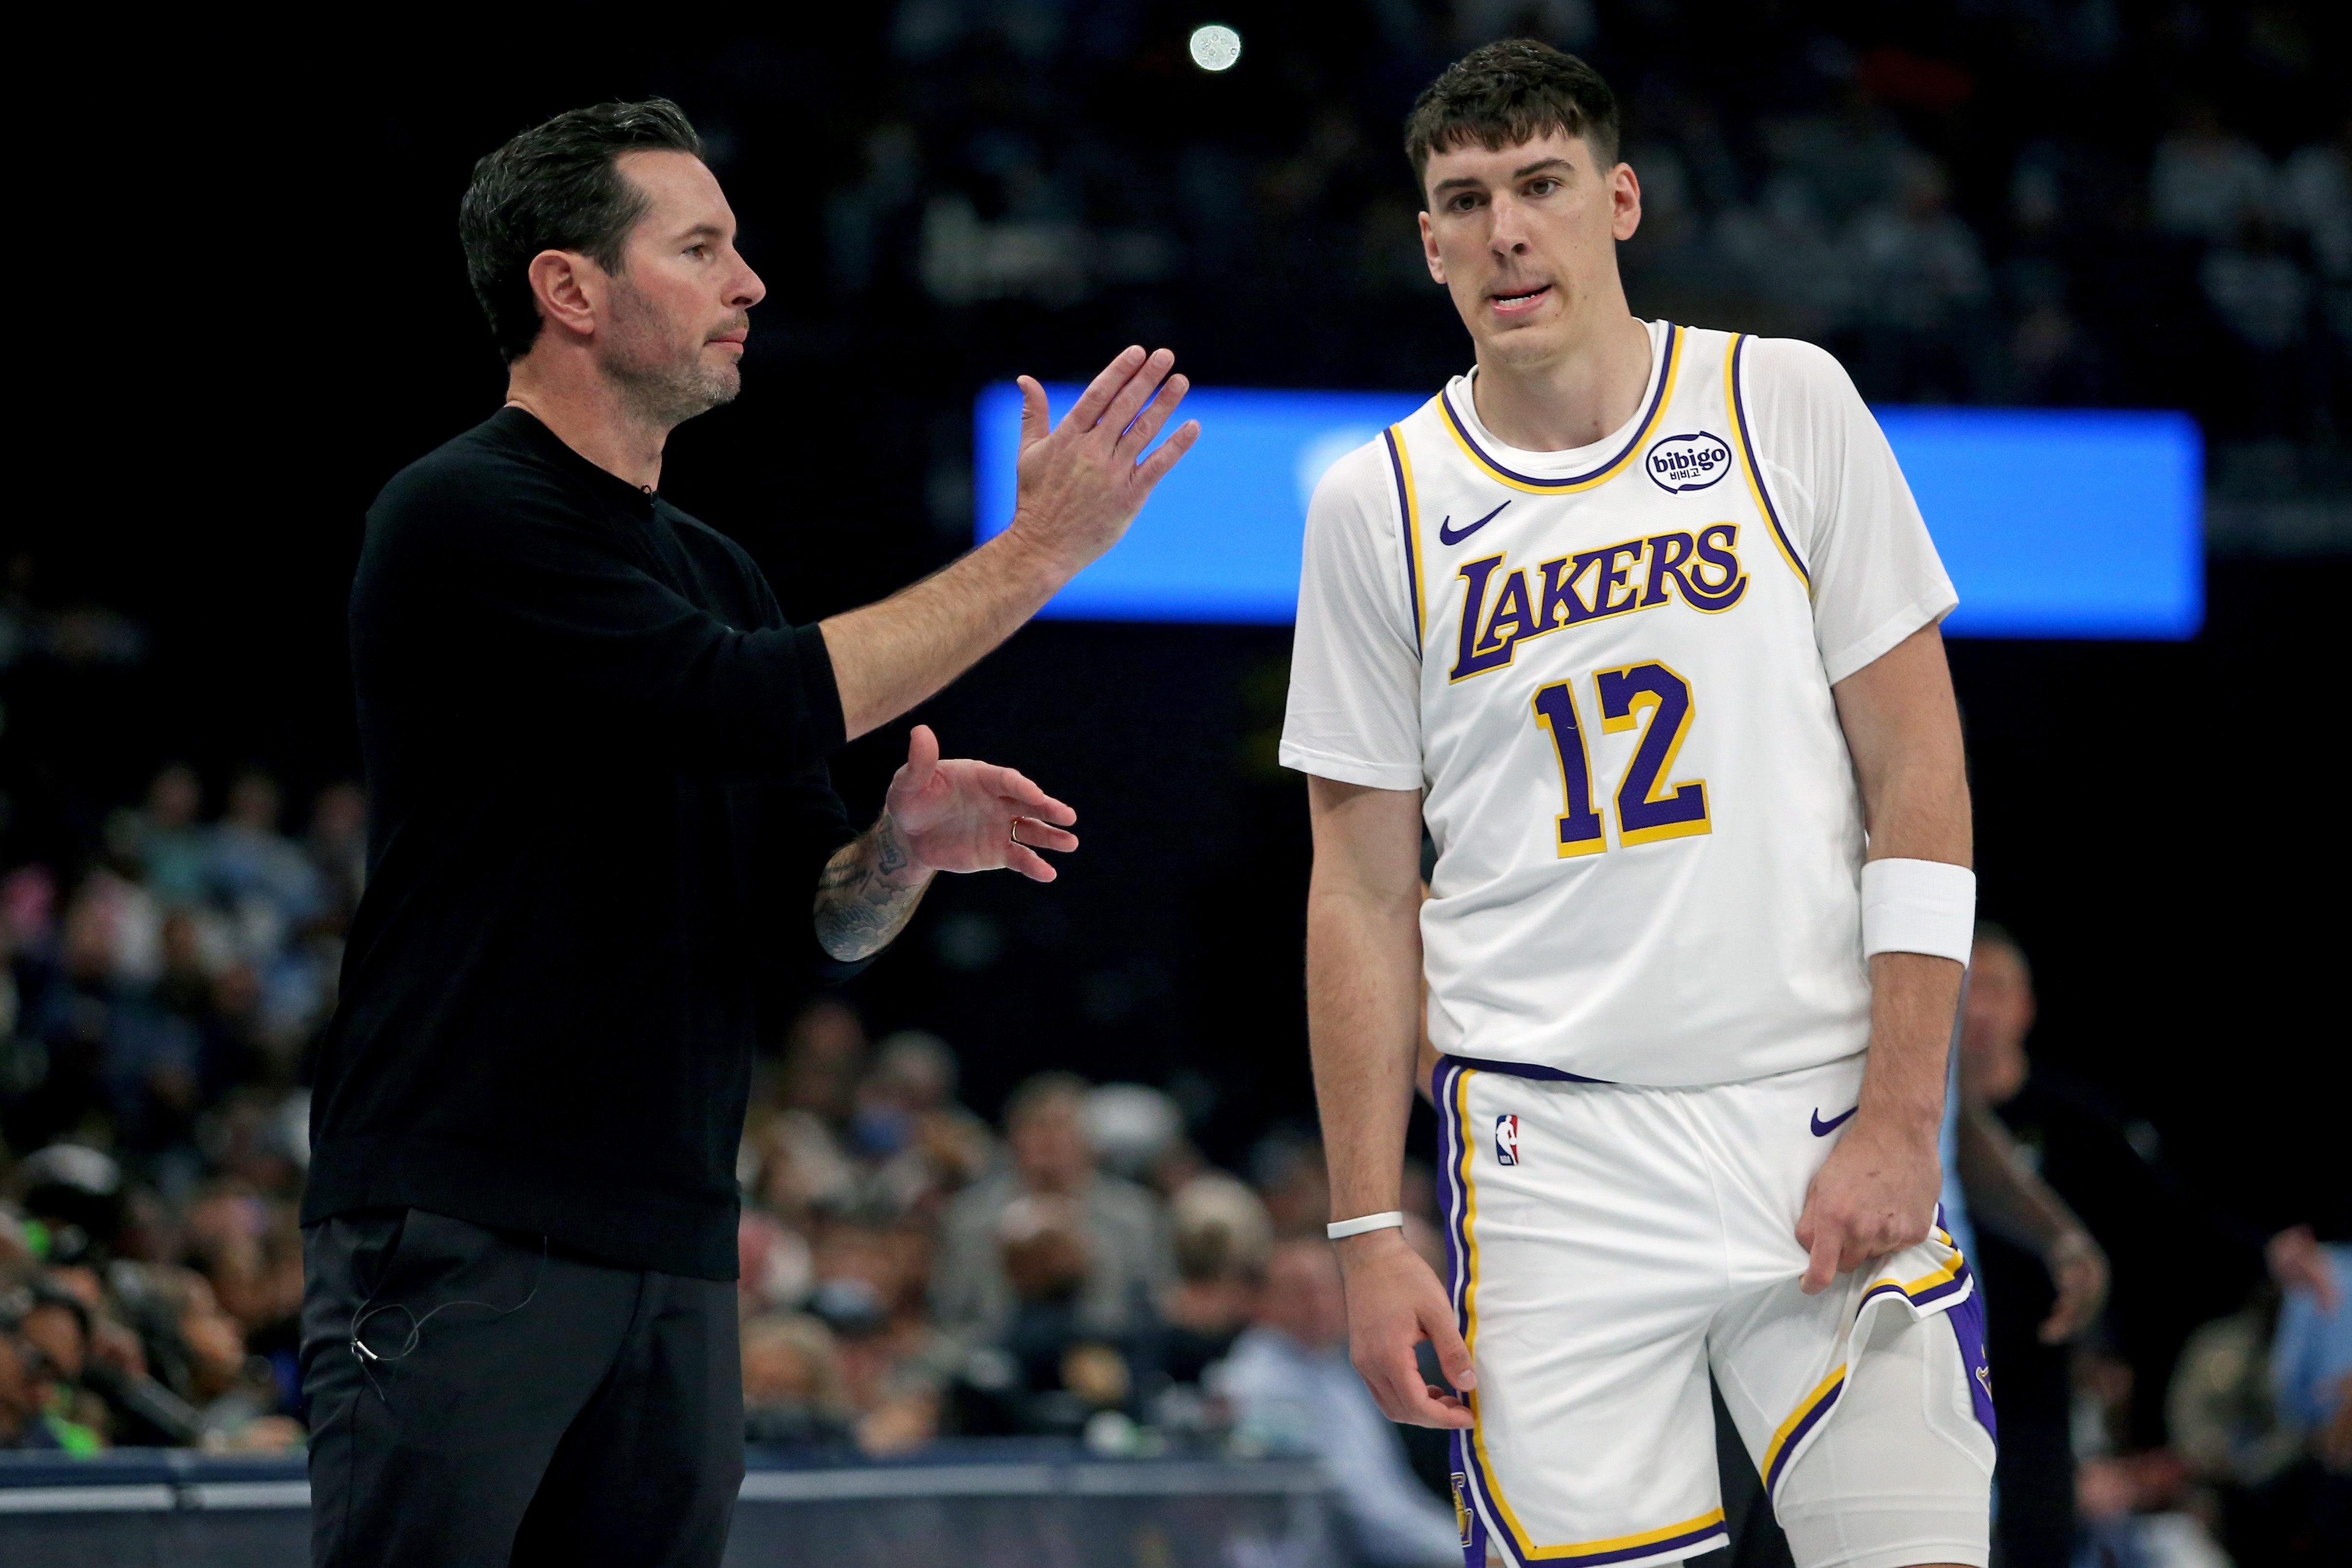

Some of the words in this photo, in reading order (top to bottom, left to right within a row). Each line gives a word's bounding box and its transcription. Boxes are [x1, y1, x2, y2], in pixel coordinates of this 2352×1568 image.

[1653, 448, 1725, 472] bibigo
[1670, 469, 1701, 480] 비비고
[1449, 522, 1750, 685] LAKERS
[1530, 659, 1711, 858] 12
